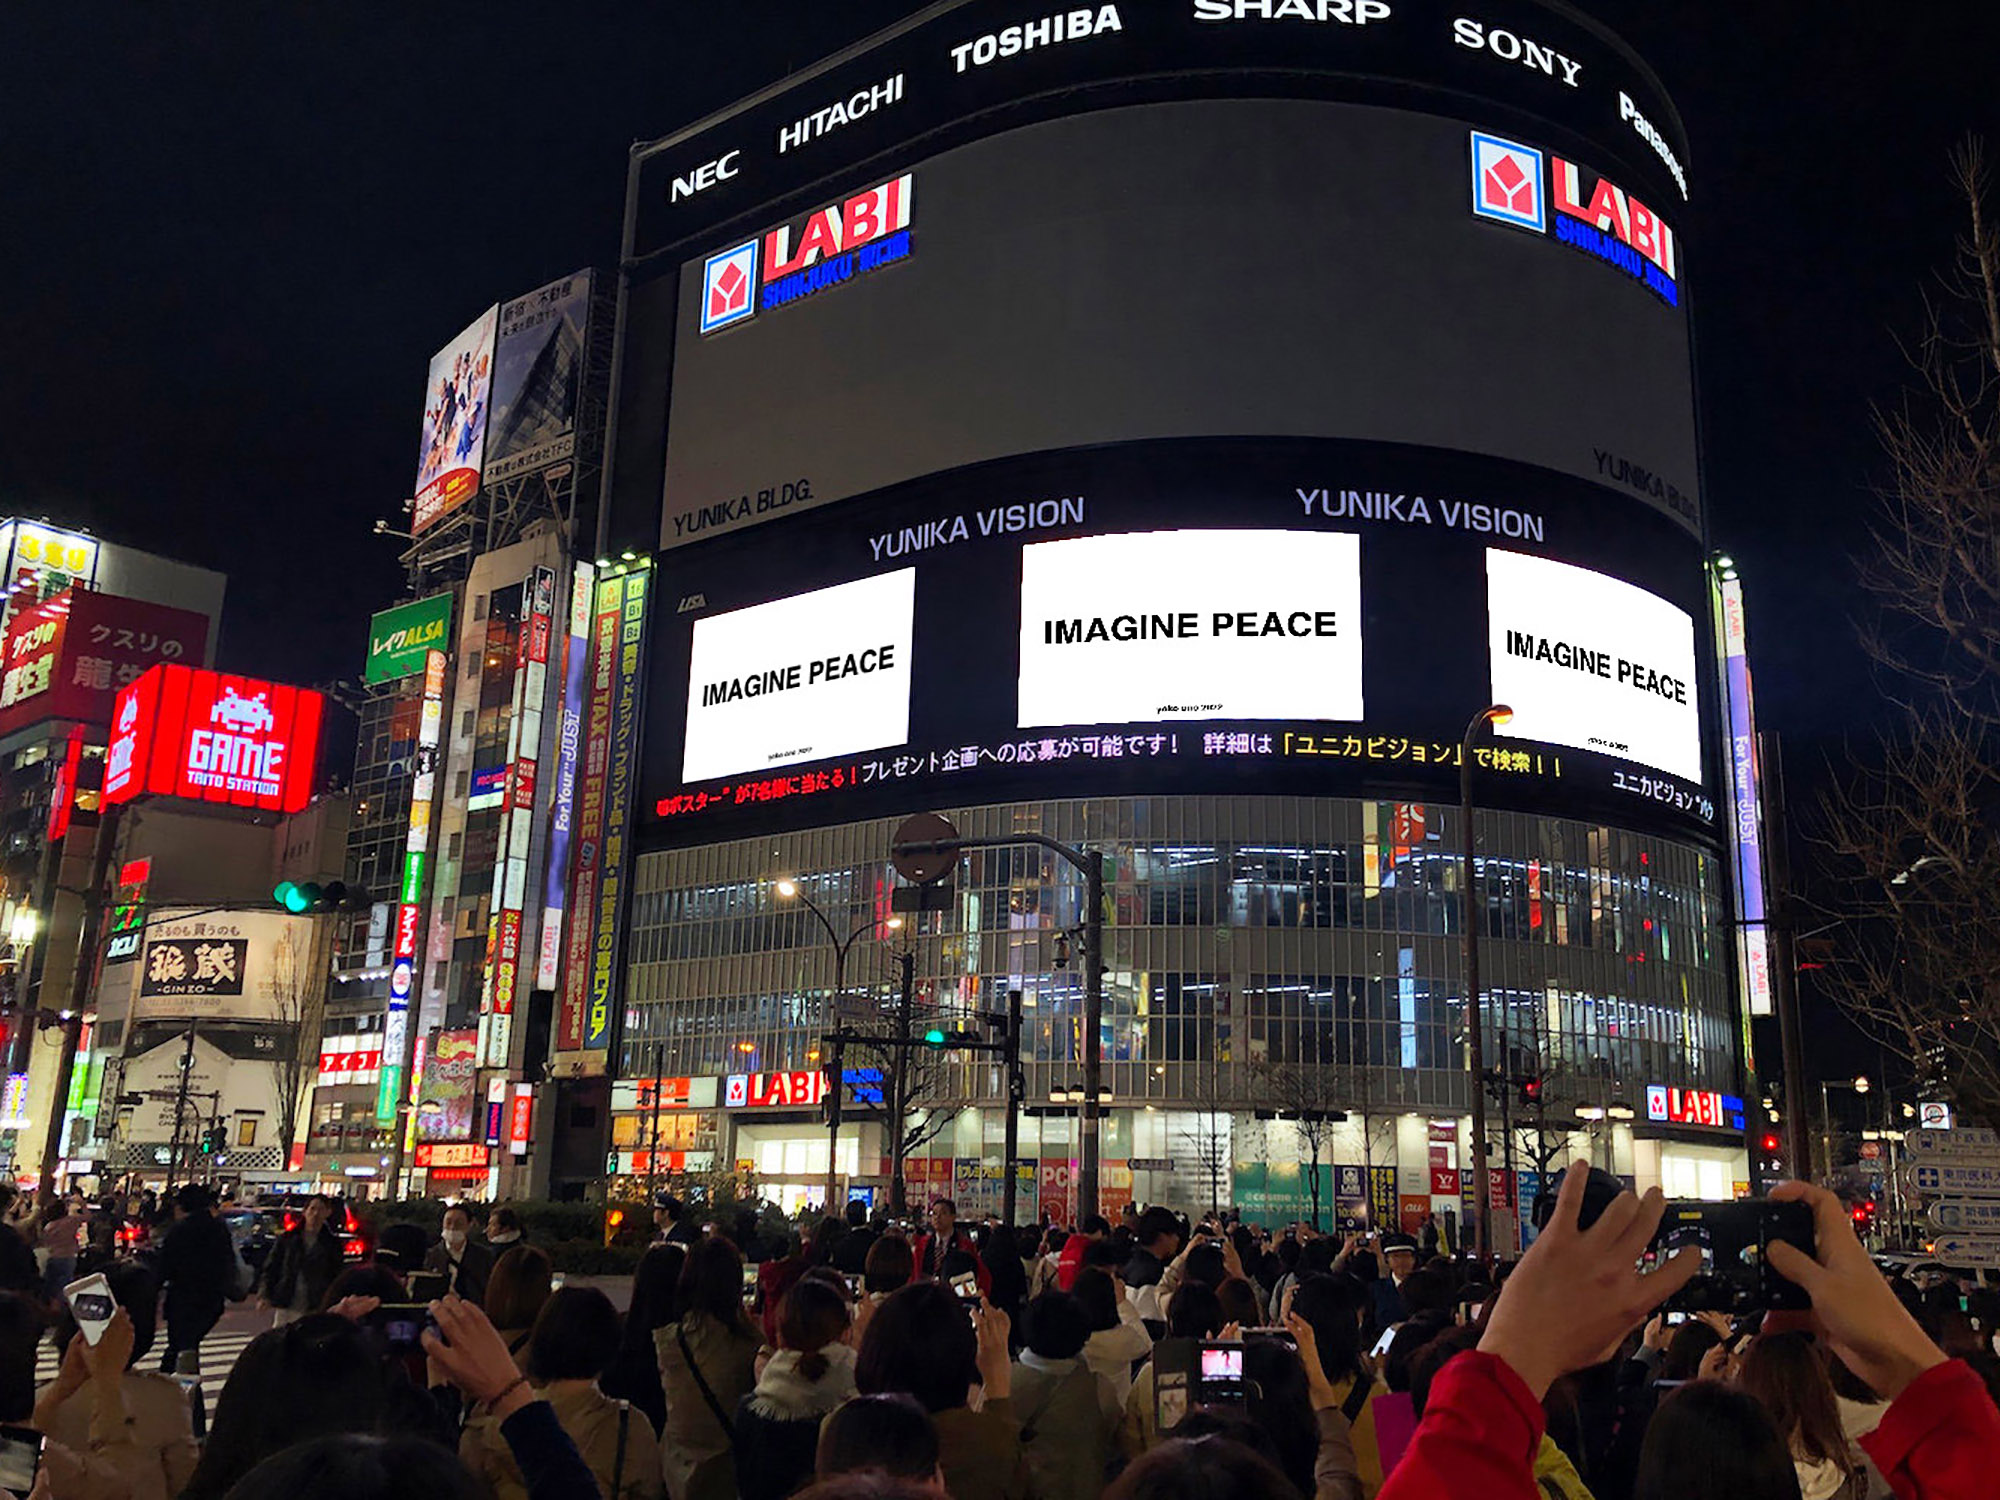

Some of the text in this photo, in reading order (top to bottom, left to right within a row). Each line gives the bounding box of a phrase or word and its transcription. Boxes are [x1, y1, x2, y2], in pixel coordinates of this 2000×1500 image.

[950, 4, 1123, 74] TOSHIBA
[1193, 0, 1391, 25] SHARP
[1453, 17, 1583, 88] SONY
[779, 73, 905, 154] HITACHI
[670, 150, 741, 203] NEC
[763, 173, 913, 283] LABI
[1551, 155, 1676, 280] LABI
[1555, 215, 1643, 278] SHINJUKU
[761, 254, 854, 310] SHINJUKU
[673, 478, 815, 538] YUNIKA BLDG.
[868, 496, 1085, 562] YUNIKA VISION
[1296, 487, 1544, 542] YUNIKA VISION
[89, 623, 183, 658] クスリの
[372, 618, 444, 657] レイクALSA
[1044, 611, 1337, 645] IMAGINE PEACE
[72, 656, 146, 692] 龍生
[702, 644, 896, 708] IMAGINE PEACE
[1506, 629, 1688, 706] IMAGINE PEACE
[561, 709, 581, 761] JUST
[590, 690, 610, 738] TAX
[188, 729, 285, 782] GAME
[187, 770, 279, 796] TAITO STATION
[581, 776, 603, 839] FREE
[554, 806, 571, 832] For
[398, 905, 417, 956] アイフル
[747, 1071, 825, 1106] LABI
[1668, 1087, 1724, 1126] LABI
[1404, 1202, 1424, 1213] au
